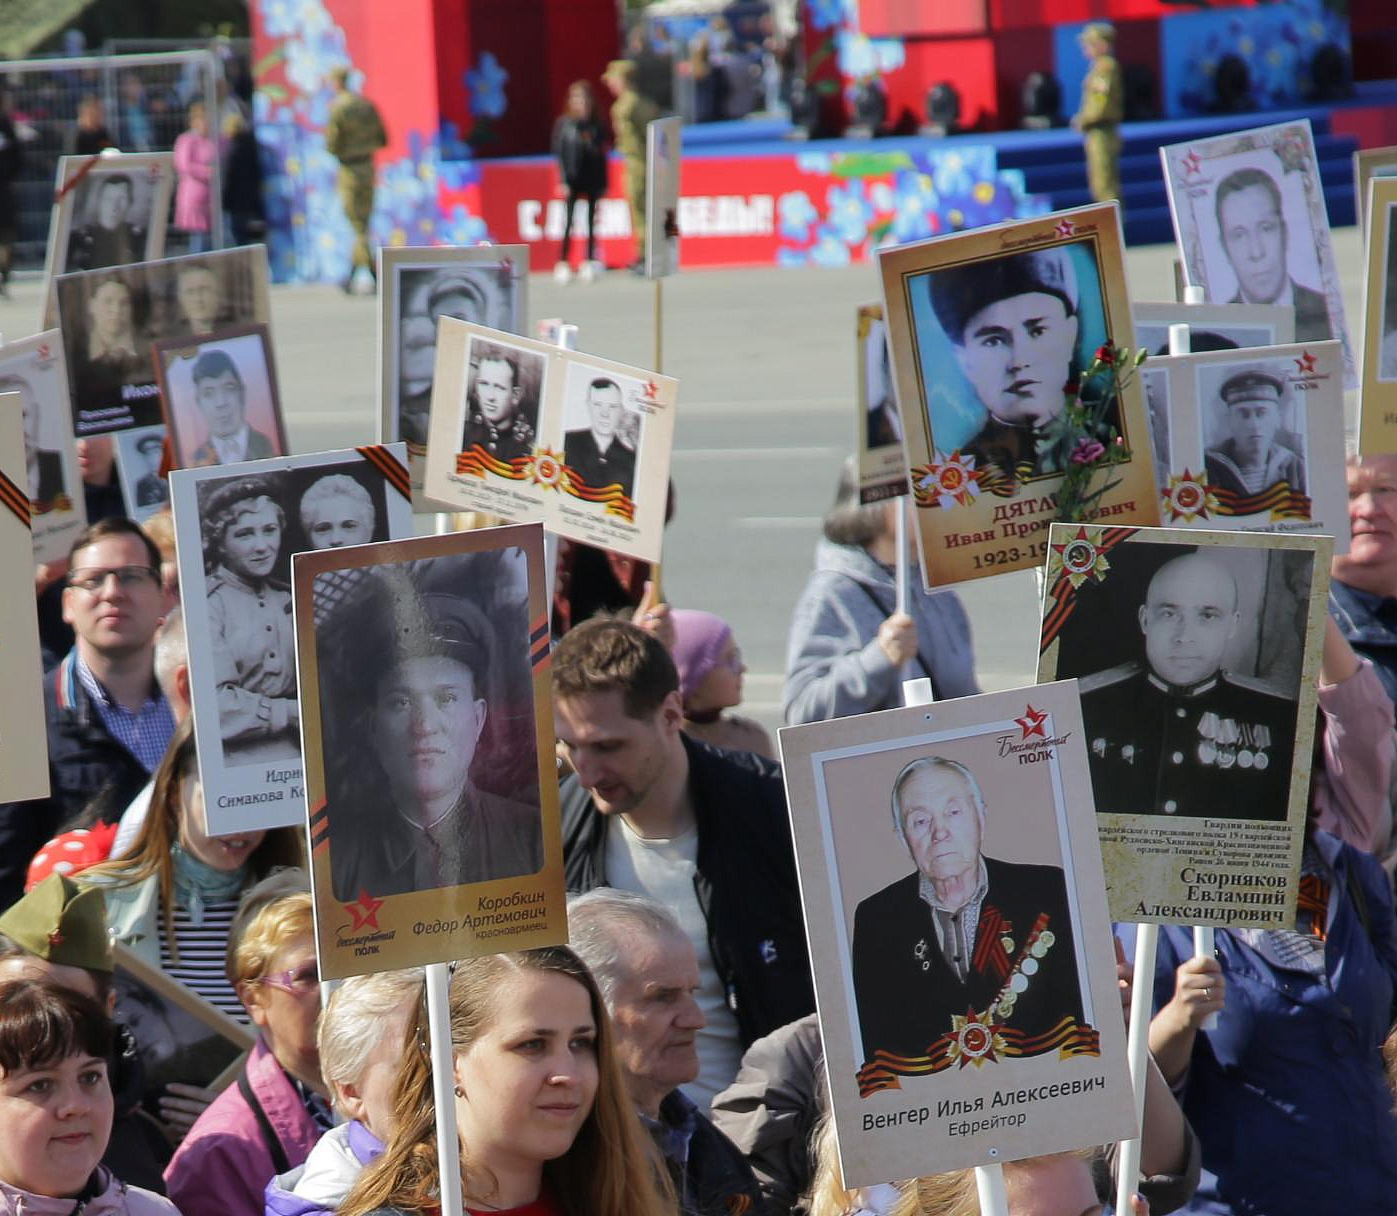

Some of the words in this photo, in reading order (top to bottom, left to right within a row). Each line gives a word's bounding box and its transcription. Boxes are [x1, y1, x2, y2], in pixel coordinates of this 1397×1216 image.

[944, 529, 995, 549] Иван
[1019, 750, 1054, 765] ПОЛК
[217, 790, 284, 809] Симакова
[1180, 867, 1288, 889] Скорняков
[477, 889, 546, 912] Коробкин
[1187, 884, 1285, 906] Евлампий
[413, 919, 458, 936] Федор
[463, 906, 547, 930] Артемович
[1134, 900, 1284, 925] Александрович
[475, 922, 549, 941] красноармеец
[354, 946, 381, 957] ПОЛК
[863, 1105, 930, 1131] Венгер
[937, 1097, 984, 1118] Илья
[991, 1076, 1106, 1109] Алексеевич
[948, 1112, 1027, 1137] Ефрейтор
